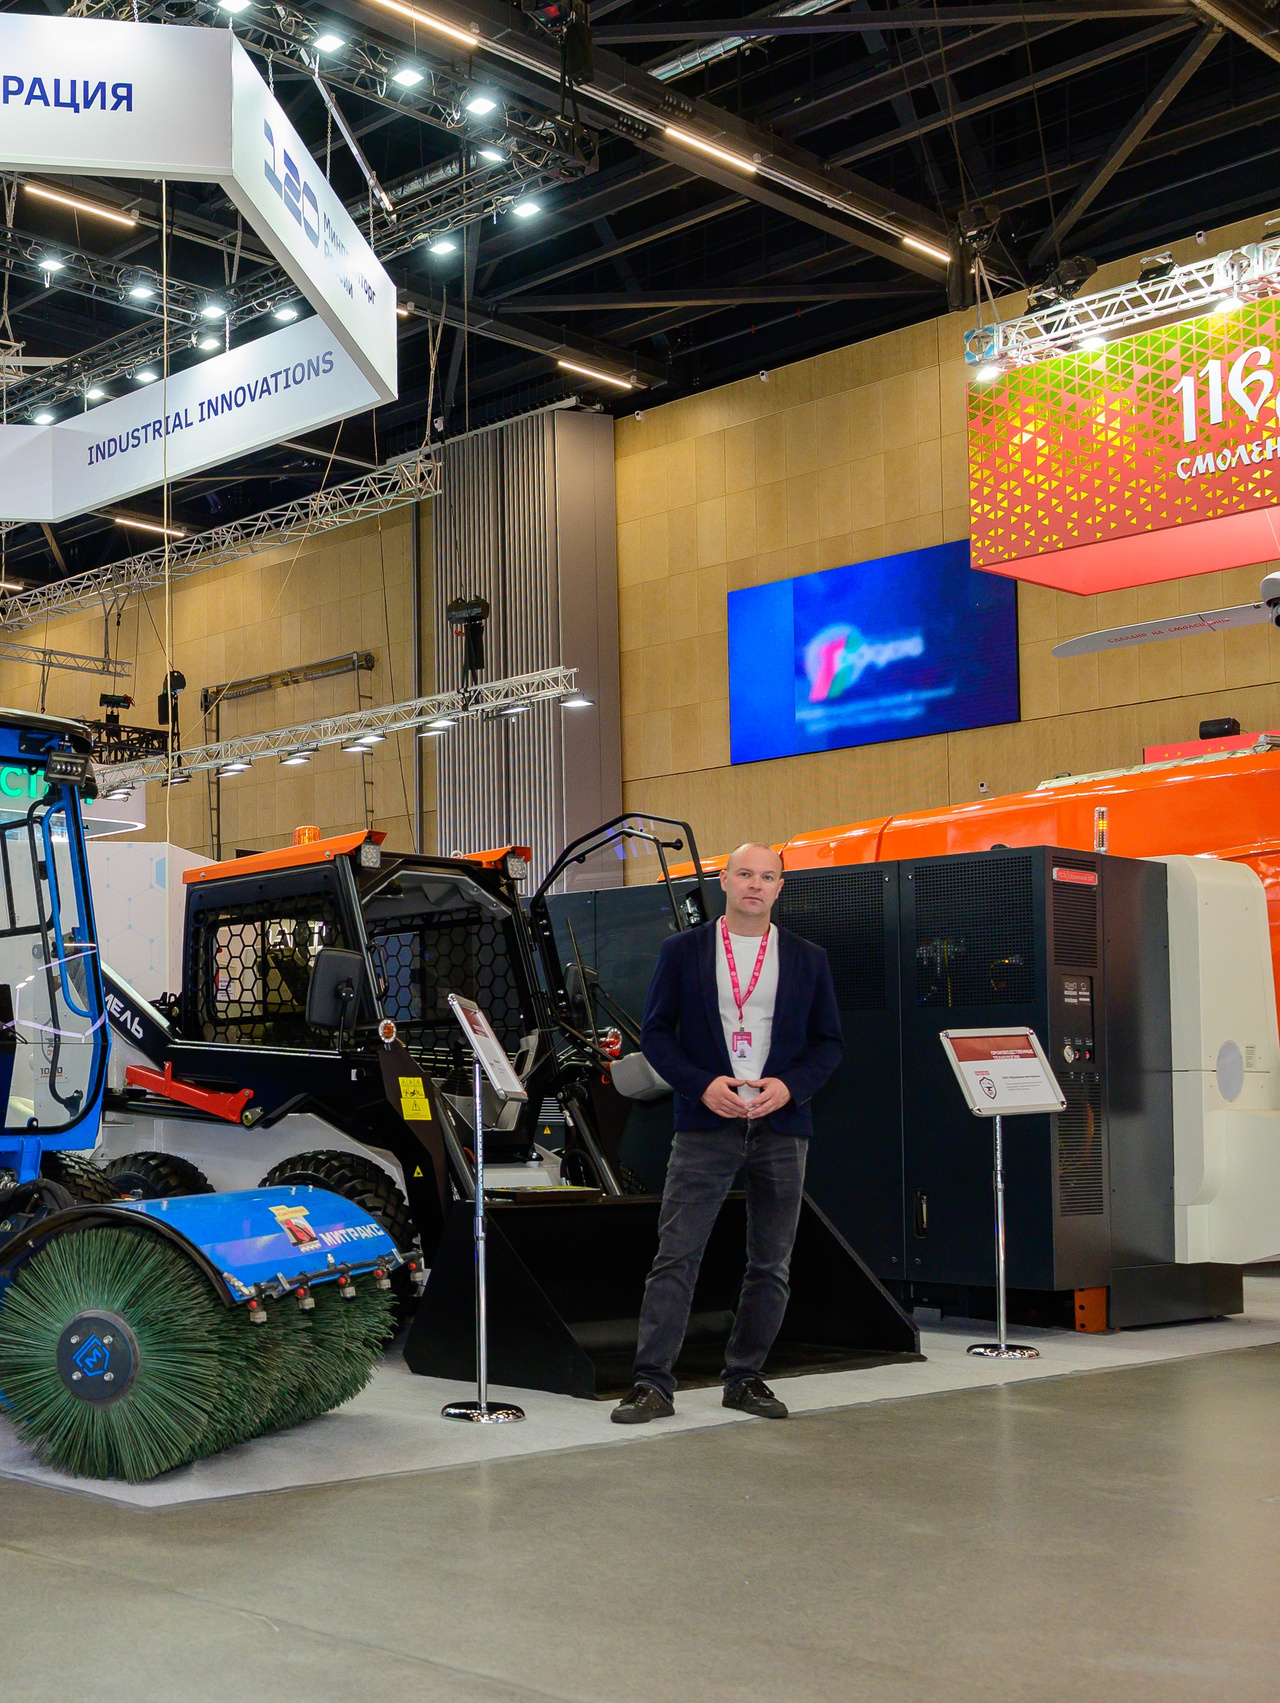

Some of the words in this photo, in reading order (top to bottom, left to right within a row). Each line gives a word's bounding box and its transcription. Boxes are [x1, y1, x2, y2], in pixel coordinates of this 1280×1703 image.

[87, 408, 194, 467] INDUSTRIAL
[198, 350, 335, 423] INNOVATIONS
[1172, 345, 1280, 443] 116
[318, 1223, 385, 1247] МИТРАКС
